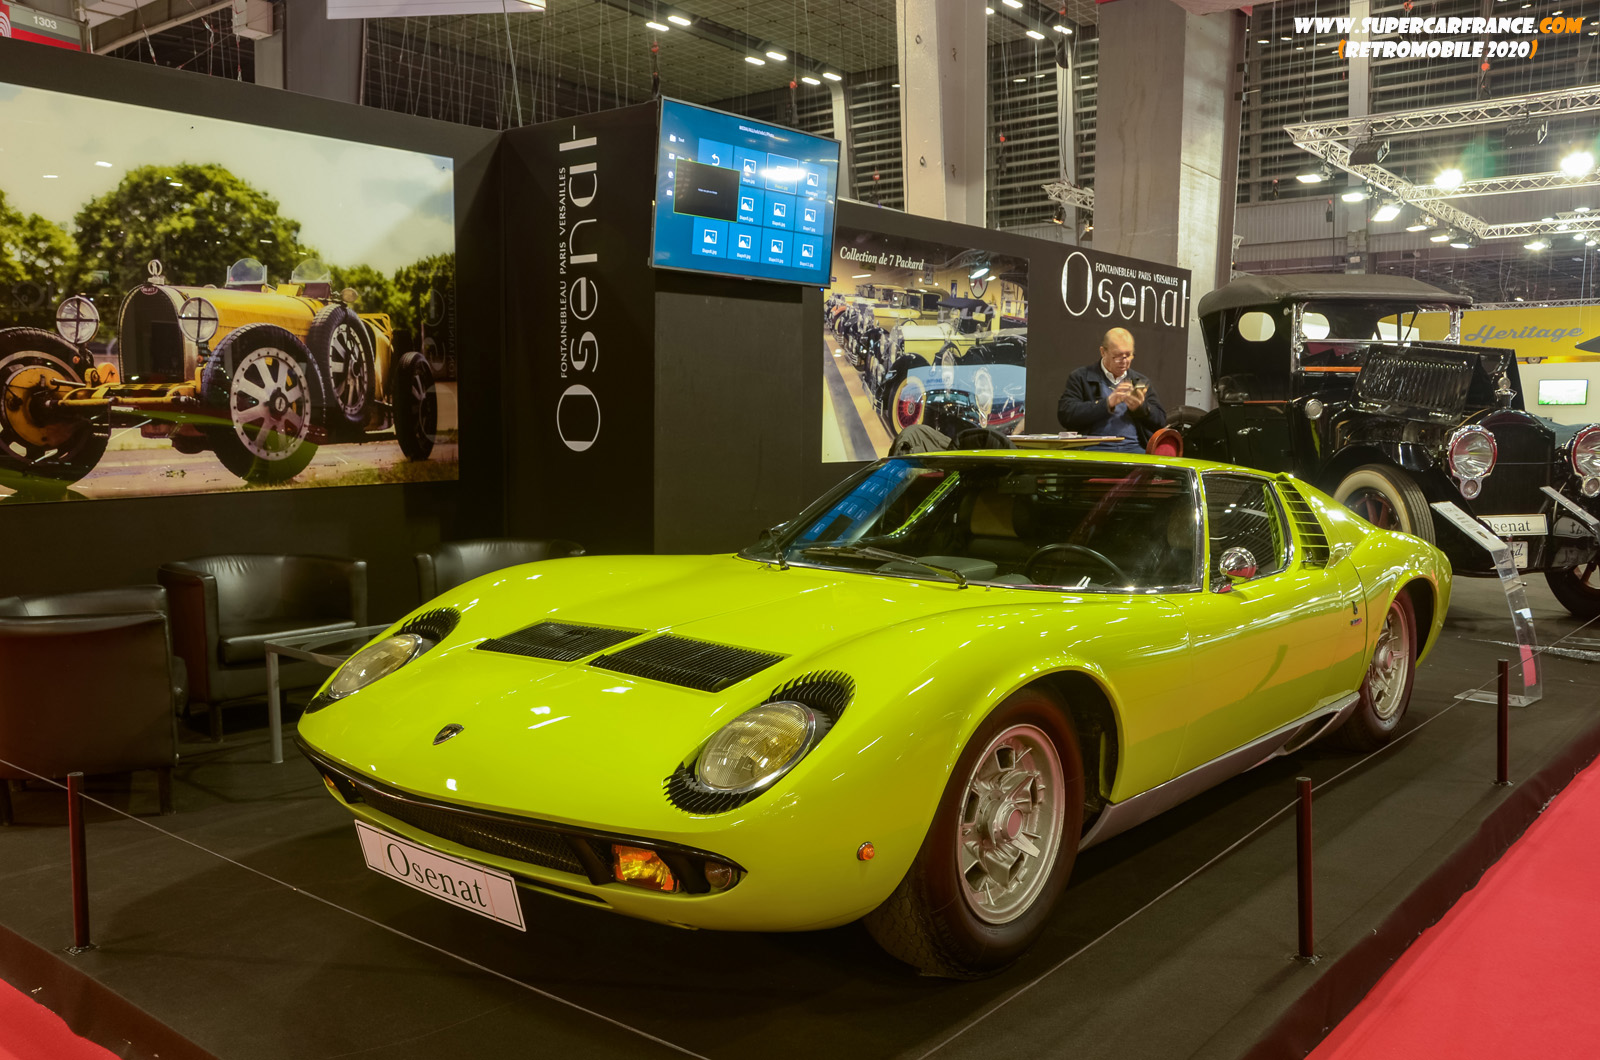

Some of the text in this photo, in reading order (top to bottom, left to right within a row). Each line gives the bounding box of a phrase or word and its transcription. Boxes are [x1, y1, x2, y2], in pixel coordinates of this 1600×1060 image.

[33, 16, 57, 29] 1303
[559, 241, 567, 275] PARIS
[839, 246, 925, 271] Collection de 7 Packard
[1095, 262, 1178, 286] FONTAINEBLEAU PARIS VERSAILLES
[556, 125, 600, 452] Osenat
[1061, 251, 1190, 328] Osenat
[560, 281, 568, 378] FONTAINEBLEAU
[1464, 324, 1584, 344] Heritage
[387, 843, 487, 908] Osenat
